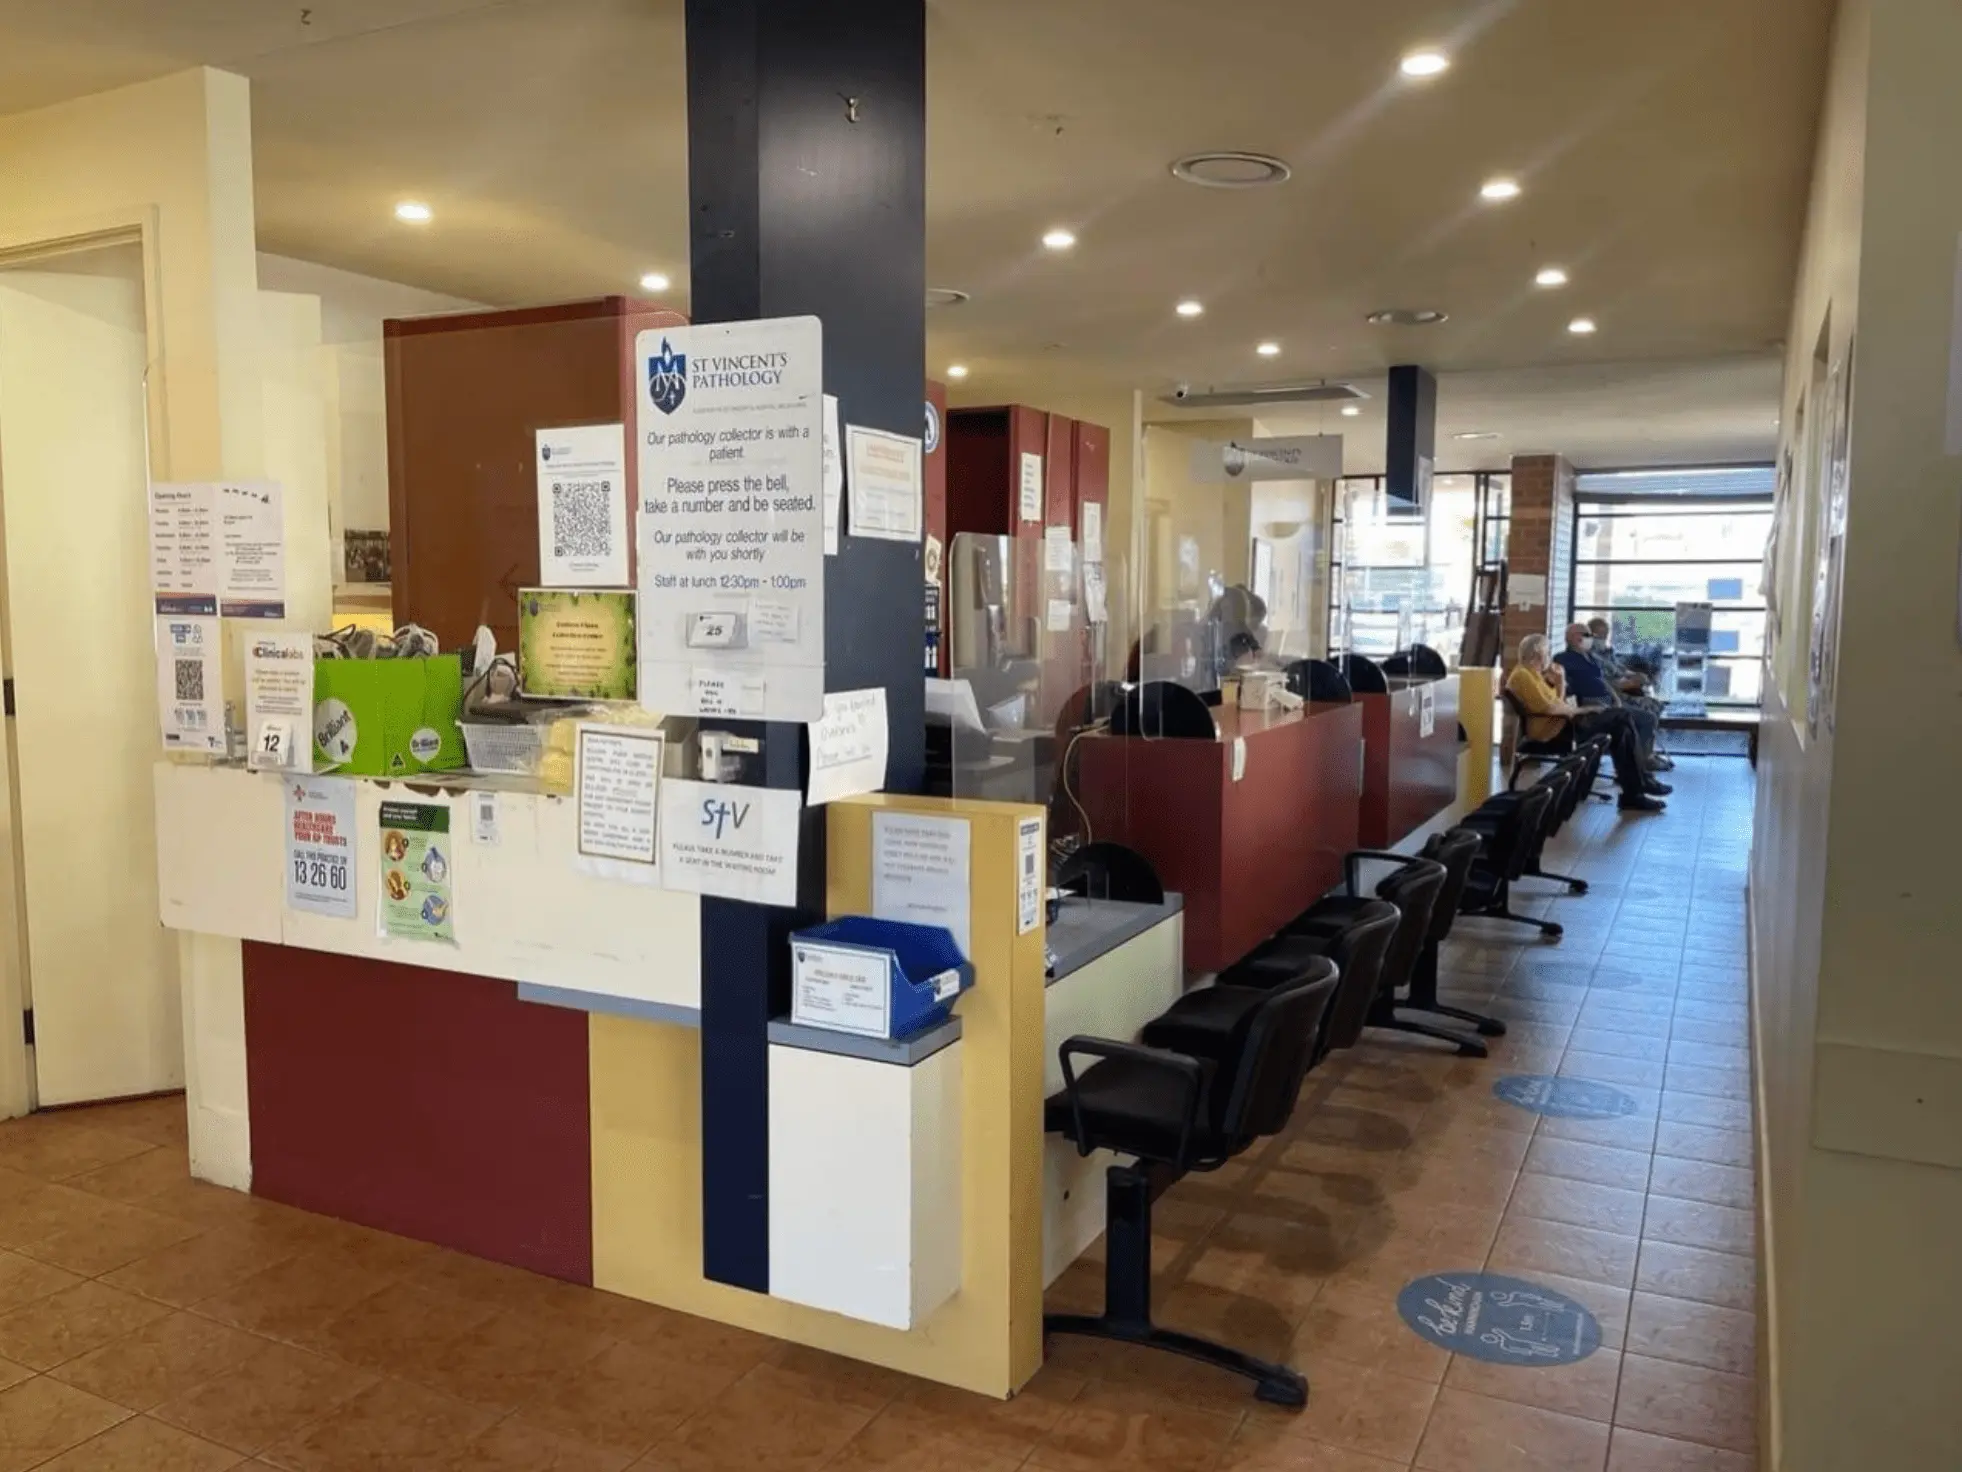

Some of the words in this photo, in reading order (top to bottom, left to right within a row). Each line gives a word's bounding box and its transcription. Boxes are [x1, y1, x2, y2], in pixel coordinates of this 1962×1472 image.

[692, 358, 708, 373] ST
[711, 352, 788, 371] VINCENT'S
[692, 370, 783, 389] PATHOLOGY
[647, 431, 664, 446] Our
[668, 429, 716, 447] pathology
[719, 427, 762, 442] collector
[765, 428, 774, 440] is
[778, 424, 799, 439] with
[802, 427, 809, 438] a
[667, 476, 704, 494] Please
[708, 480, 740, 495] press
[743, 475, 763, 492] the
[766, 474, 790, 493] bell,
[645, 500, 668, 514] take
[671, 502, 679, 513] a
[682, 497, 724, 513] number
[728, 496, 750, 512] and
[753, 495, 769, 512] be
[773, 495, 816, 511] seated.
[654, 530, 673, 544] Our
[675, 530, 722, 546] pathology
[726, 530, 769, 543] collector
[772, 529, 789, 542] will
[791, 529, 805, 543] be
[686, 548, 707, 560] with
[710, 550, 728, 563] you
[731, 549, 765, 562] shortly
[655, 574, 677, 588] Staff
[679, 575, 689, 587] at
[692, 575, 717, 587] lunch
[706, 625, 723, 636] 25
[264, 735, 280, 752] 12
[672, 843, 696, 853] PLEASE
[697, 845, 714, 855] TAKE
[720, 848, 749, 859] NUMBER
[685, 857, 701, 866] SEAT
[703, 859, 709, 867] IN
[710, 860, 723, 868] THE
[724, 862, 752, 873] WAITING
[294, 861, 307, 884] 13
[310, 862, 327, 887] 26
[330, 866, 347, 890] 60
